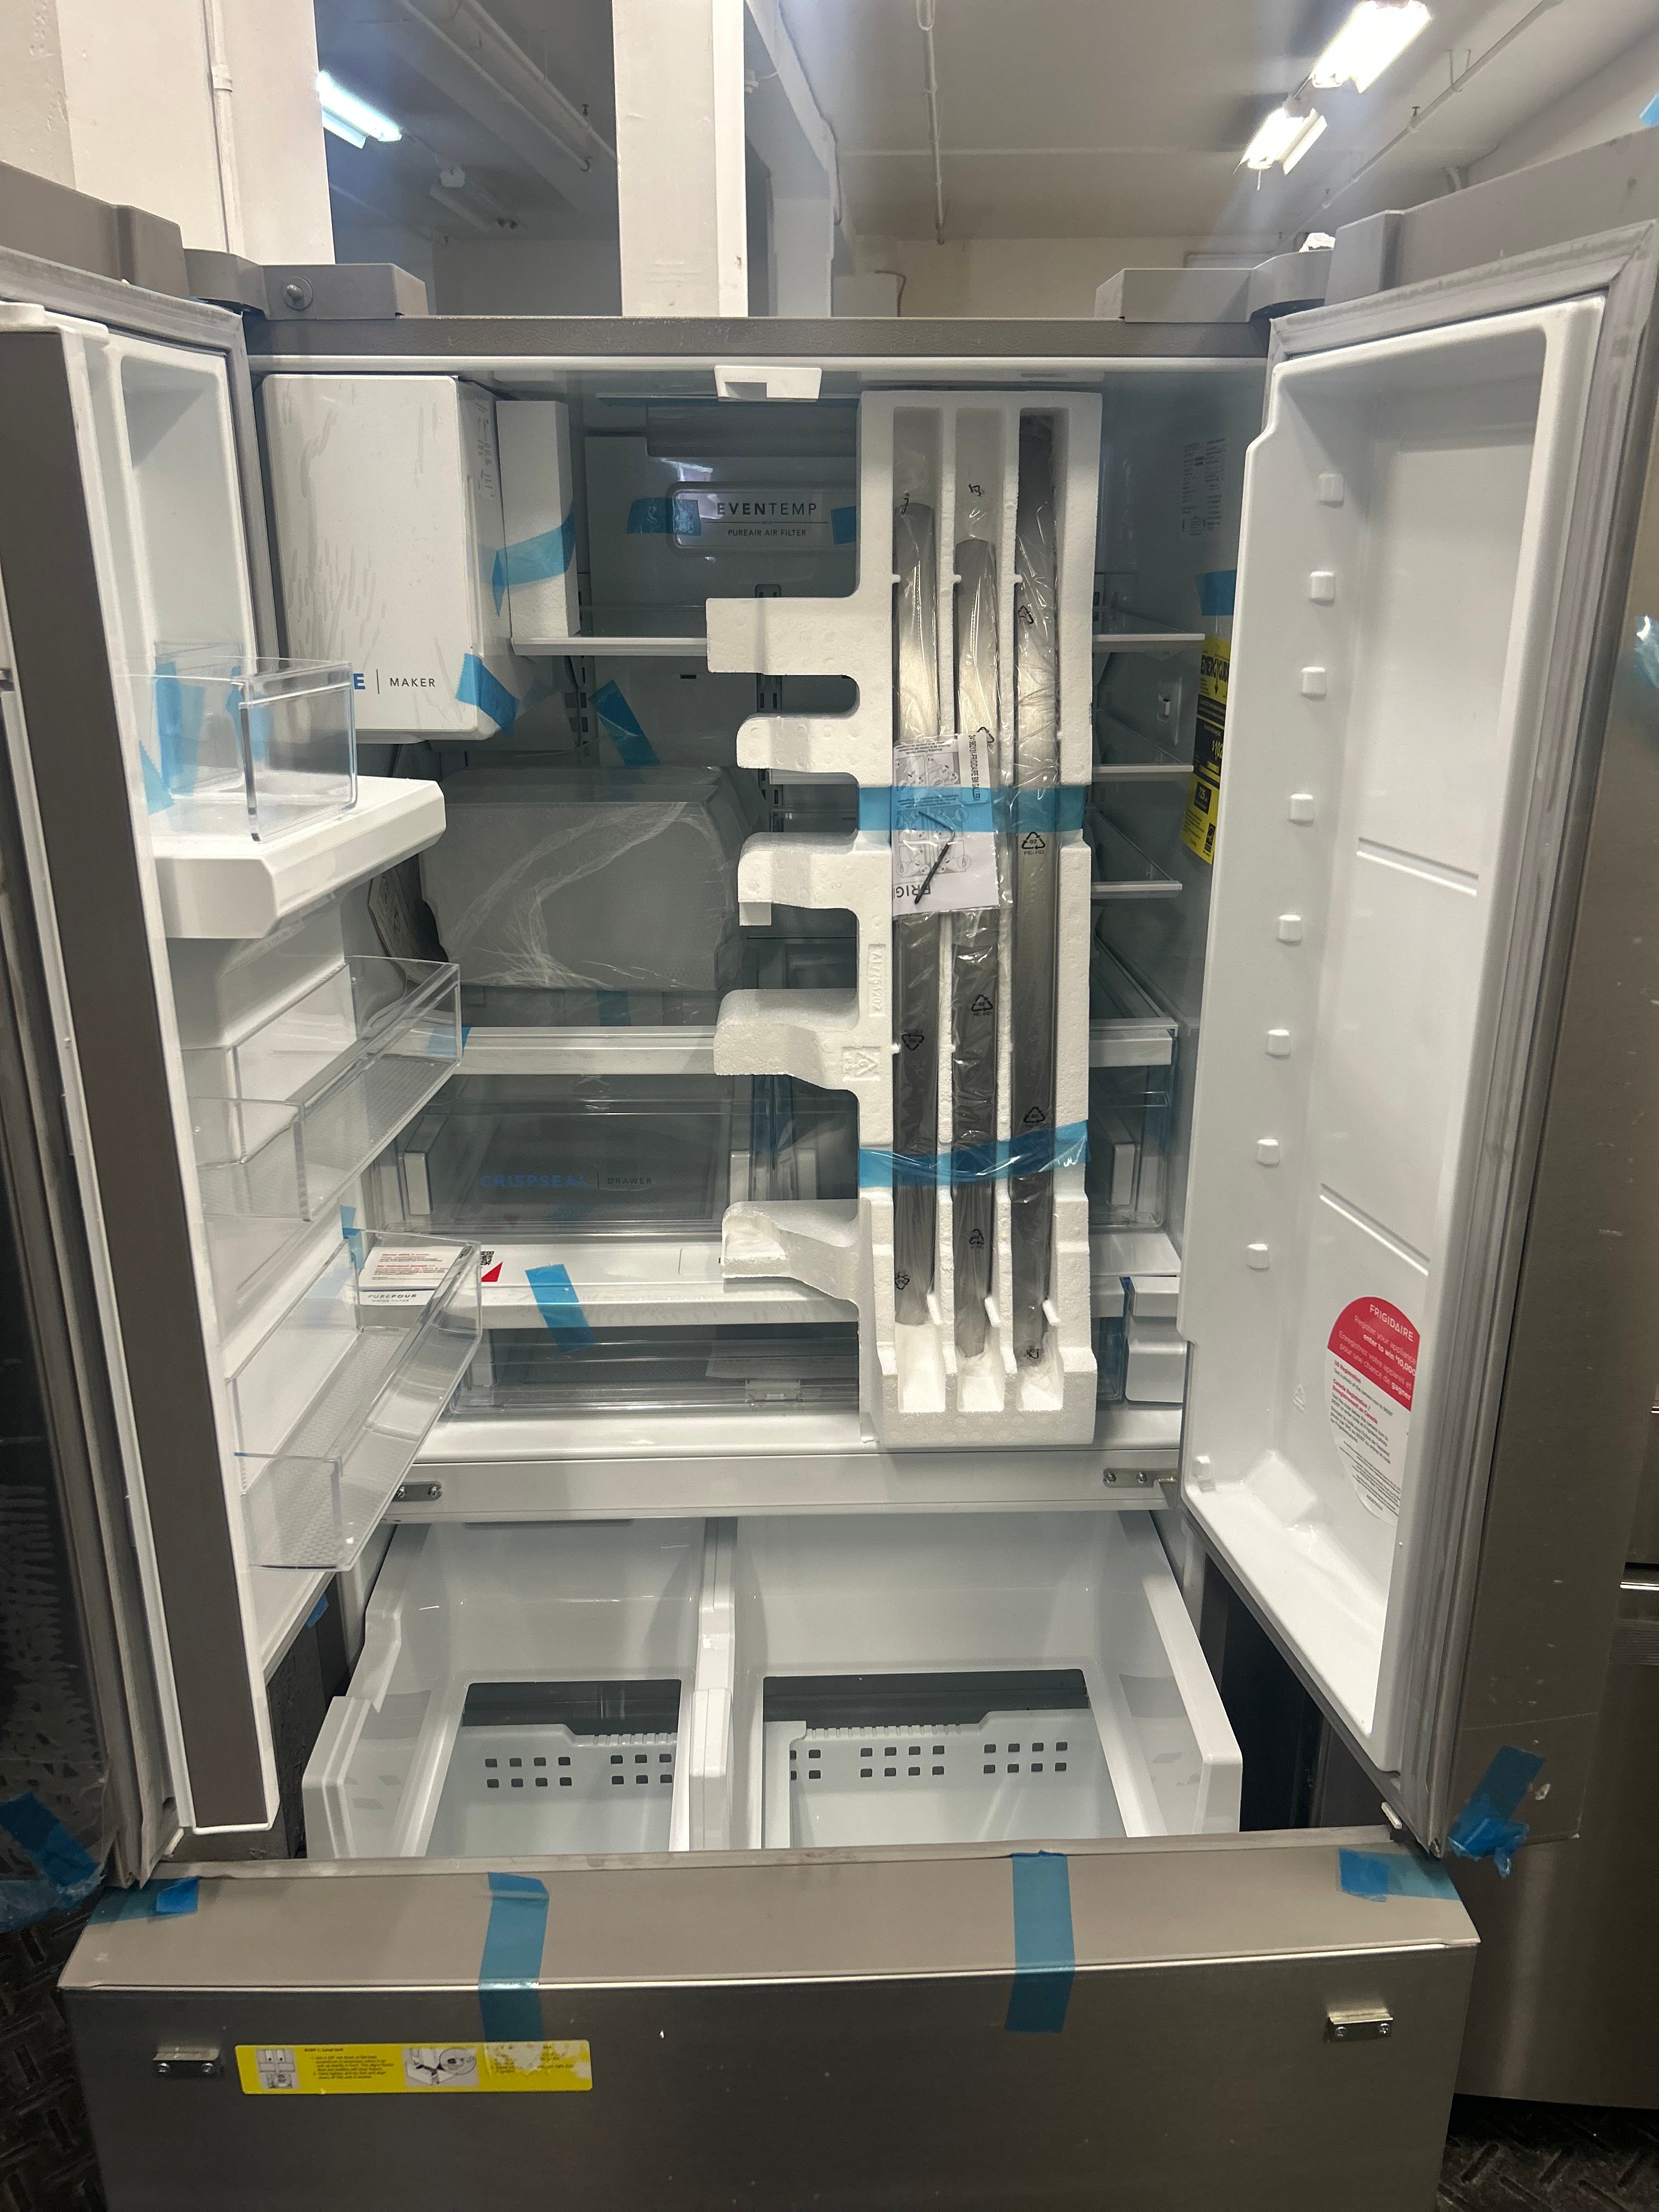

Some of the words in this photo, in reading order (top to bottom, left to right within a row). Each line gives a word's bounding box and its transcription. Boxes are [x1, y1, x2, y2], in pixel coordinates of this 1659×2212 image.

[717, 503, 816, 515] EVENTEMP
[390, 678, 436, 687] MAKER
[480, 1173, 587, 1188] CRISPSEAL
[1369, 1304, 1414, 1341] FRIGIDAIRE
[1354, 1315, 1376, 1334] Register
[1376, 1332, 1389, 1345] your
[1390, 1342, 1416, 1365] appliance
[1363, 1334, 1378, 1347] enter
[1378, 1344, 1384, 1352] to
[1385, 1349, 1395, 1361] win
[1339, 1330, 1368, 1357] Enregistrez
[1368, 1352, 1383, 1368] votre
[1383, 1364, 1405, 1384] appareil
[1406, 1381, 1412, 1391] et
[1340, 1344, 1352, 1356] pour
[1353, 1353, 1363, 1364] une
[1363, 1361, 1383, 1379] chance
[1383, 1374, 1391, 1385] de
